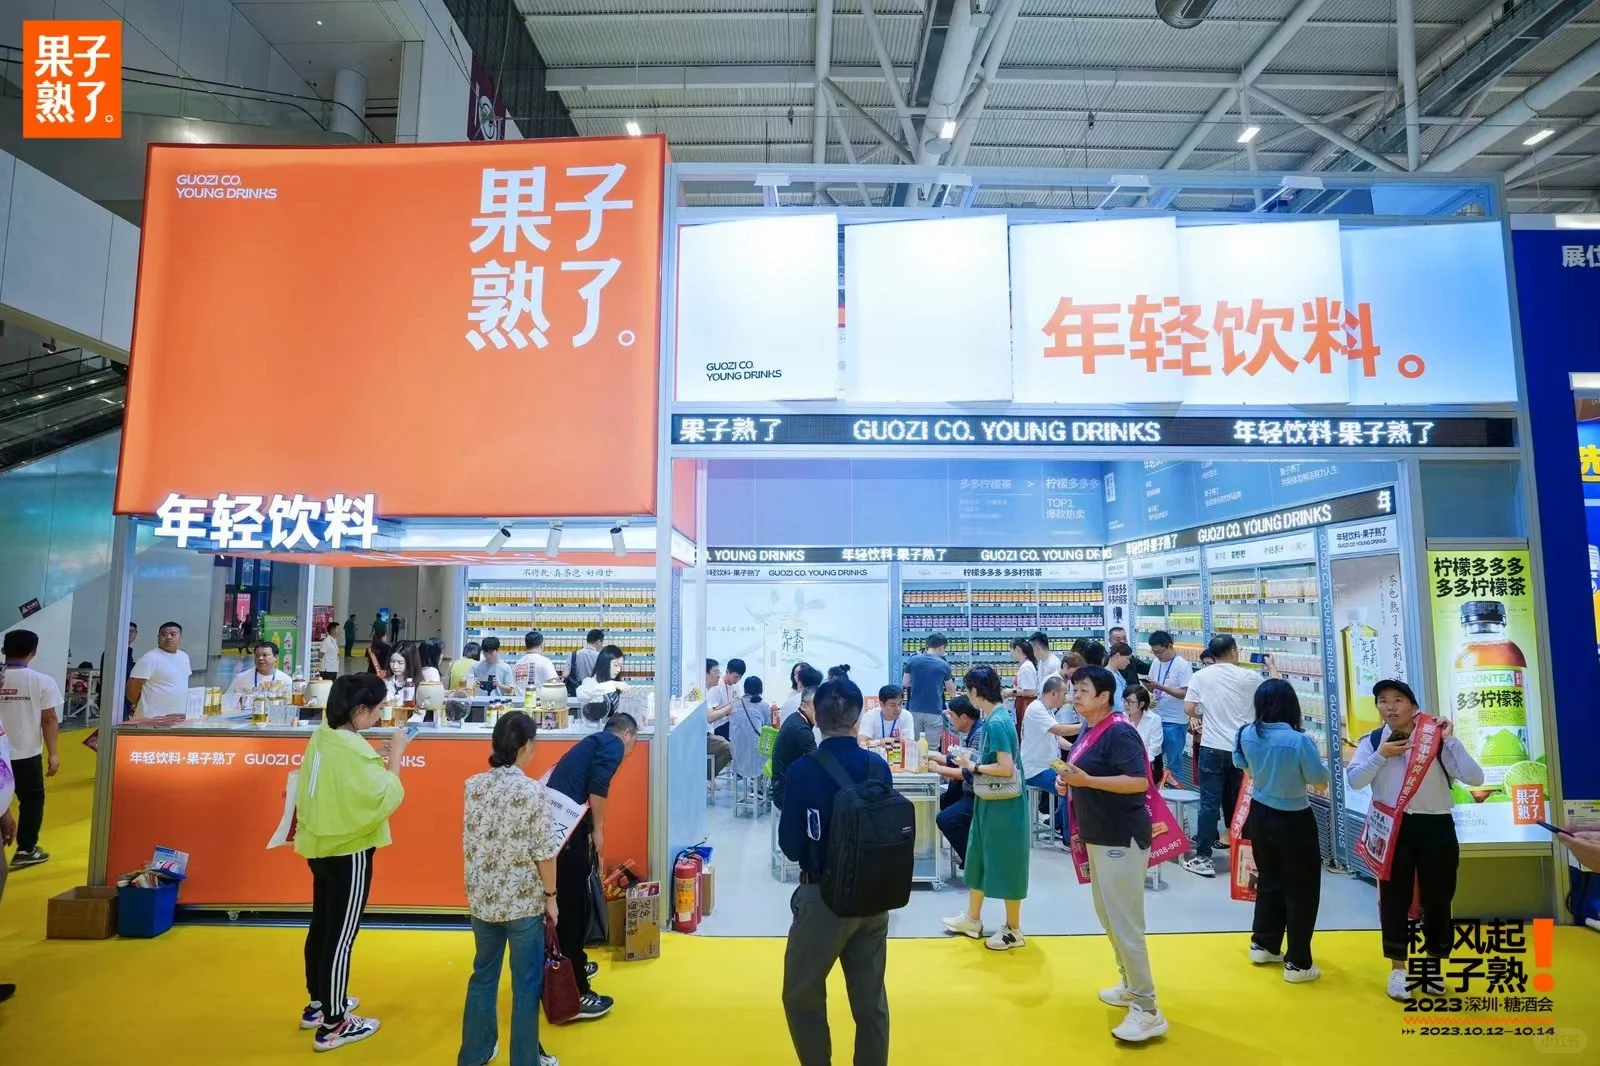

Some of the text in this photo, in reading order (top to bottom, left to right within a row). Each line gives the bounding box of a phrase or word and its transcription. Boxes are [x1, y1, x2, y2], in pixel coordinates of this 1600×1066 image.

[177, 174, 242, 185] GUOZI CO.
[176, 187, 277, 199] YOUNG DRINKS
[470, 163, 634, 254] 果子
[706, 361, 755, 371] GUOZI CO.
[706, 370, 782, 382] YOUNG DRINKS
[680, 418, 782, 443] 果子熟了
[853, 420, 1161, 442] GUOZI CO. YOUNG DRINKS
[1045, 478, 1100, 490] 柠檬多多多
[1047, 498, 1074, 508] TOP1
[154, 492, 379, 549] 年轻饮料
[1198, 503, 1332, 543] GUOZI CO. YOUNG DRINKS
[715, 549, 805, 561] YOUNG DRINKS
[980, 549, 1017, 561] GUOZI
[1019, 549, 1040, 561] CO.
[1042, 549, 1084, 561] YOUNG
[1320, 534, 1329, 570] GUOZI
[768, 569, 794, 577] GUOZI
[837, 568, 868, 577] DRINKS
[963, 568, 1042, 577] 柠檬多多多 多多柠檬茶
[1434, 557, 1525, 577] 柠檬多多多
[1436, 577, 1527, 598] 多多柠檬茶
[1324, 594, 1332, 636] YOUNG
[1327, 639, 1336, 684] DRINKS
[1457, 690, 1524, 711] 多多柠檬茶
[244, 754, 289, 765] GUOZI
[292, 754, 304, 766] C
[1329, 694, 1346, 849] GUOZI CO. YOUNG DRINKS
[1516, 788, 1540, 804] 果子
